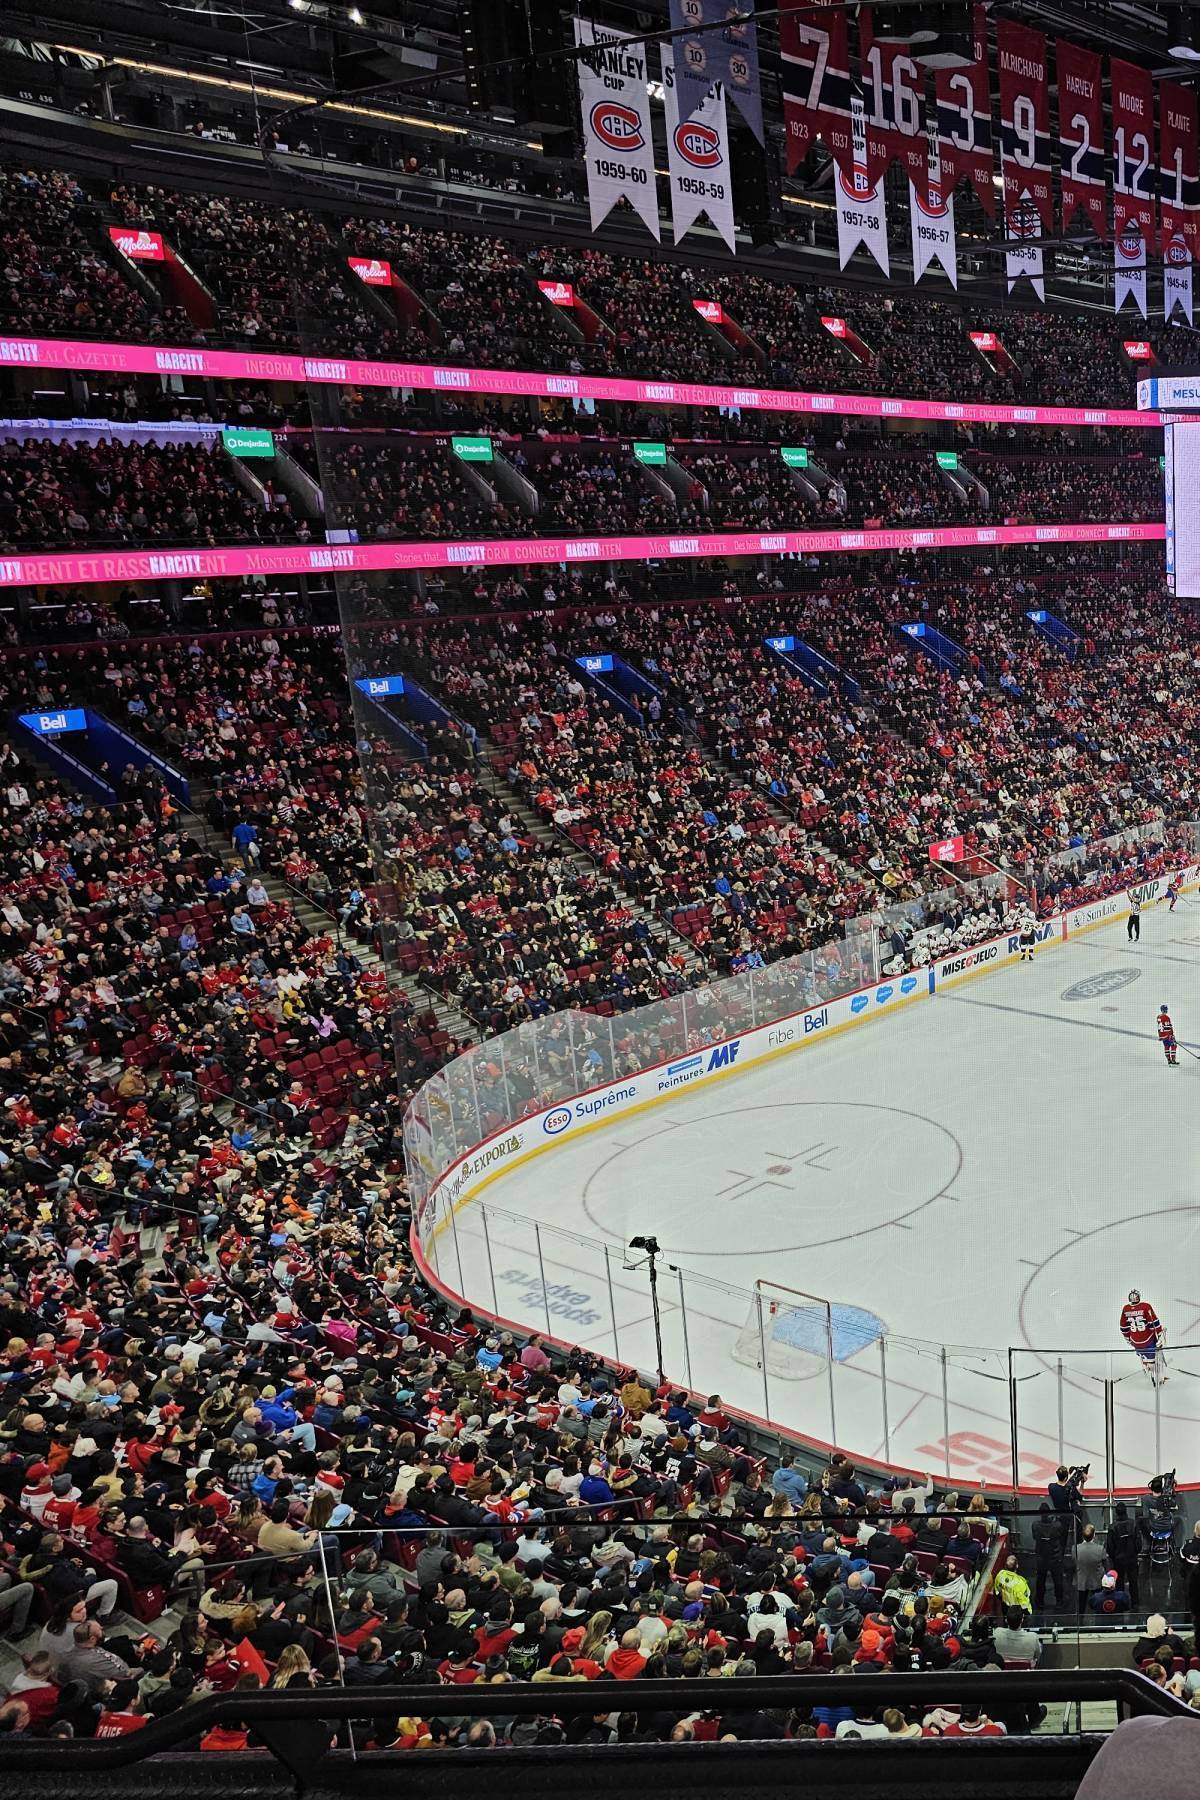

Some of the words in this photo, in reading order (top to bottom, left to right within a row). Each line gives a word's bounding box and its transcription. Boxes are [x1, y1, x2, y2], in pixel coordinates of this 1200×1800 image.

[689, 49, 702, 63] 10
[733, 62, 746, 75] 30
[799, 23, 829, 110] 7
[603, 75, 625, 91] CUP
[867, 46, 920, 136] 16
[1066, 74, 1094, 99] HARVEY
[950, 74, 975, 151] 3
[1119, 92, 1144, 116] MOORE
[1167, 110, 1191, 132] PLANTE
[790, 121, 809, 139] 1923
[1014, 95, 1035, 168] 9
[831, 132, 848, 149] 1937
[869, 142, 887, 158] 1940
[1071, 114, 1090, 185] 2
[907, 152, 923, 167] 1954
[941, 159, 955, 176] 1941
[1114, 127, 1150, 200] 12
[594, 160, 647, 184] 1959-60
[974, 169, 989, 184] 1956
[1173, 147, 1184, 209] 1
[677, 177, 724, 199] 1958-59
[1004, 176, 1019, 192] 1942
[842, 210, 879, 230] 1957-58
[116, 236, 158, 251] Molson
[917, 226, 950, 244] 1956-57
[354, 264, 387, 278] Molson
[543, 288, 570, 299] Molson
[156, 352, 203, 371] NARCITY
[246, 360, 292, 376] INFORM
[304, 361, 347, 379] NARCITY
[434, 370, 470, 387] NARCITY
[547, 377, 578, 393] NARCITY
[646, 385, 674, 400] NARCITY
[238, 439, 270, 449] Desjardins
[669, 539, 699, 553] NARCITY
[761, 536, 786, 550] NARCITY
[310, 550, 353, 567] NARCITY
[447, 546, 485, 561] NARCITY
[515, 546, 560, 560] CONNECT
[566, 543, 600, 559] NARCITY
[150, 555, 200, 574] NARCITY
[774, 639, 785, 650] Bell
[586, 657, 603, 670] Bell
[370, 681, 389, 693] Bell
[40, 715, 66, 731] Bell
[1086, 908, 1102, 922] Sun
[1102, 900, 1117, 917] Life
[804, 1009, 828, 1033] Bell
[768, 1029, 794, 1046] Fibe
[707, 1041, 740, 1072] MF
[658, 1067, 703, 1091] Peintures
[576, 1086, 635, 1117] Suprême
[547, 1114, 568, 1129] Esso
[473, 1138, 513, 1175] EXPORT
[44, 1510, 59, 1522] PRICE
[97, 1726, 122, 1738] PRICE
